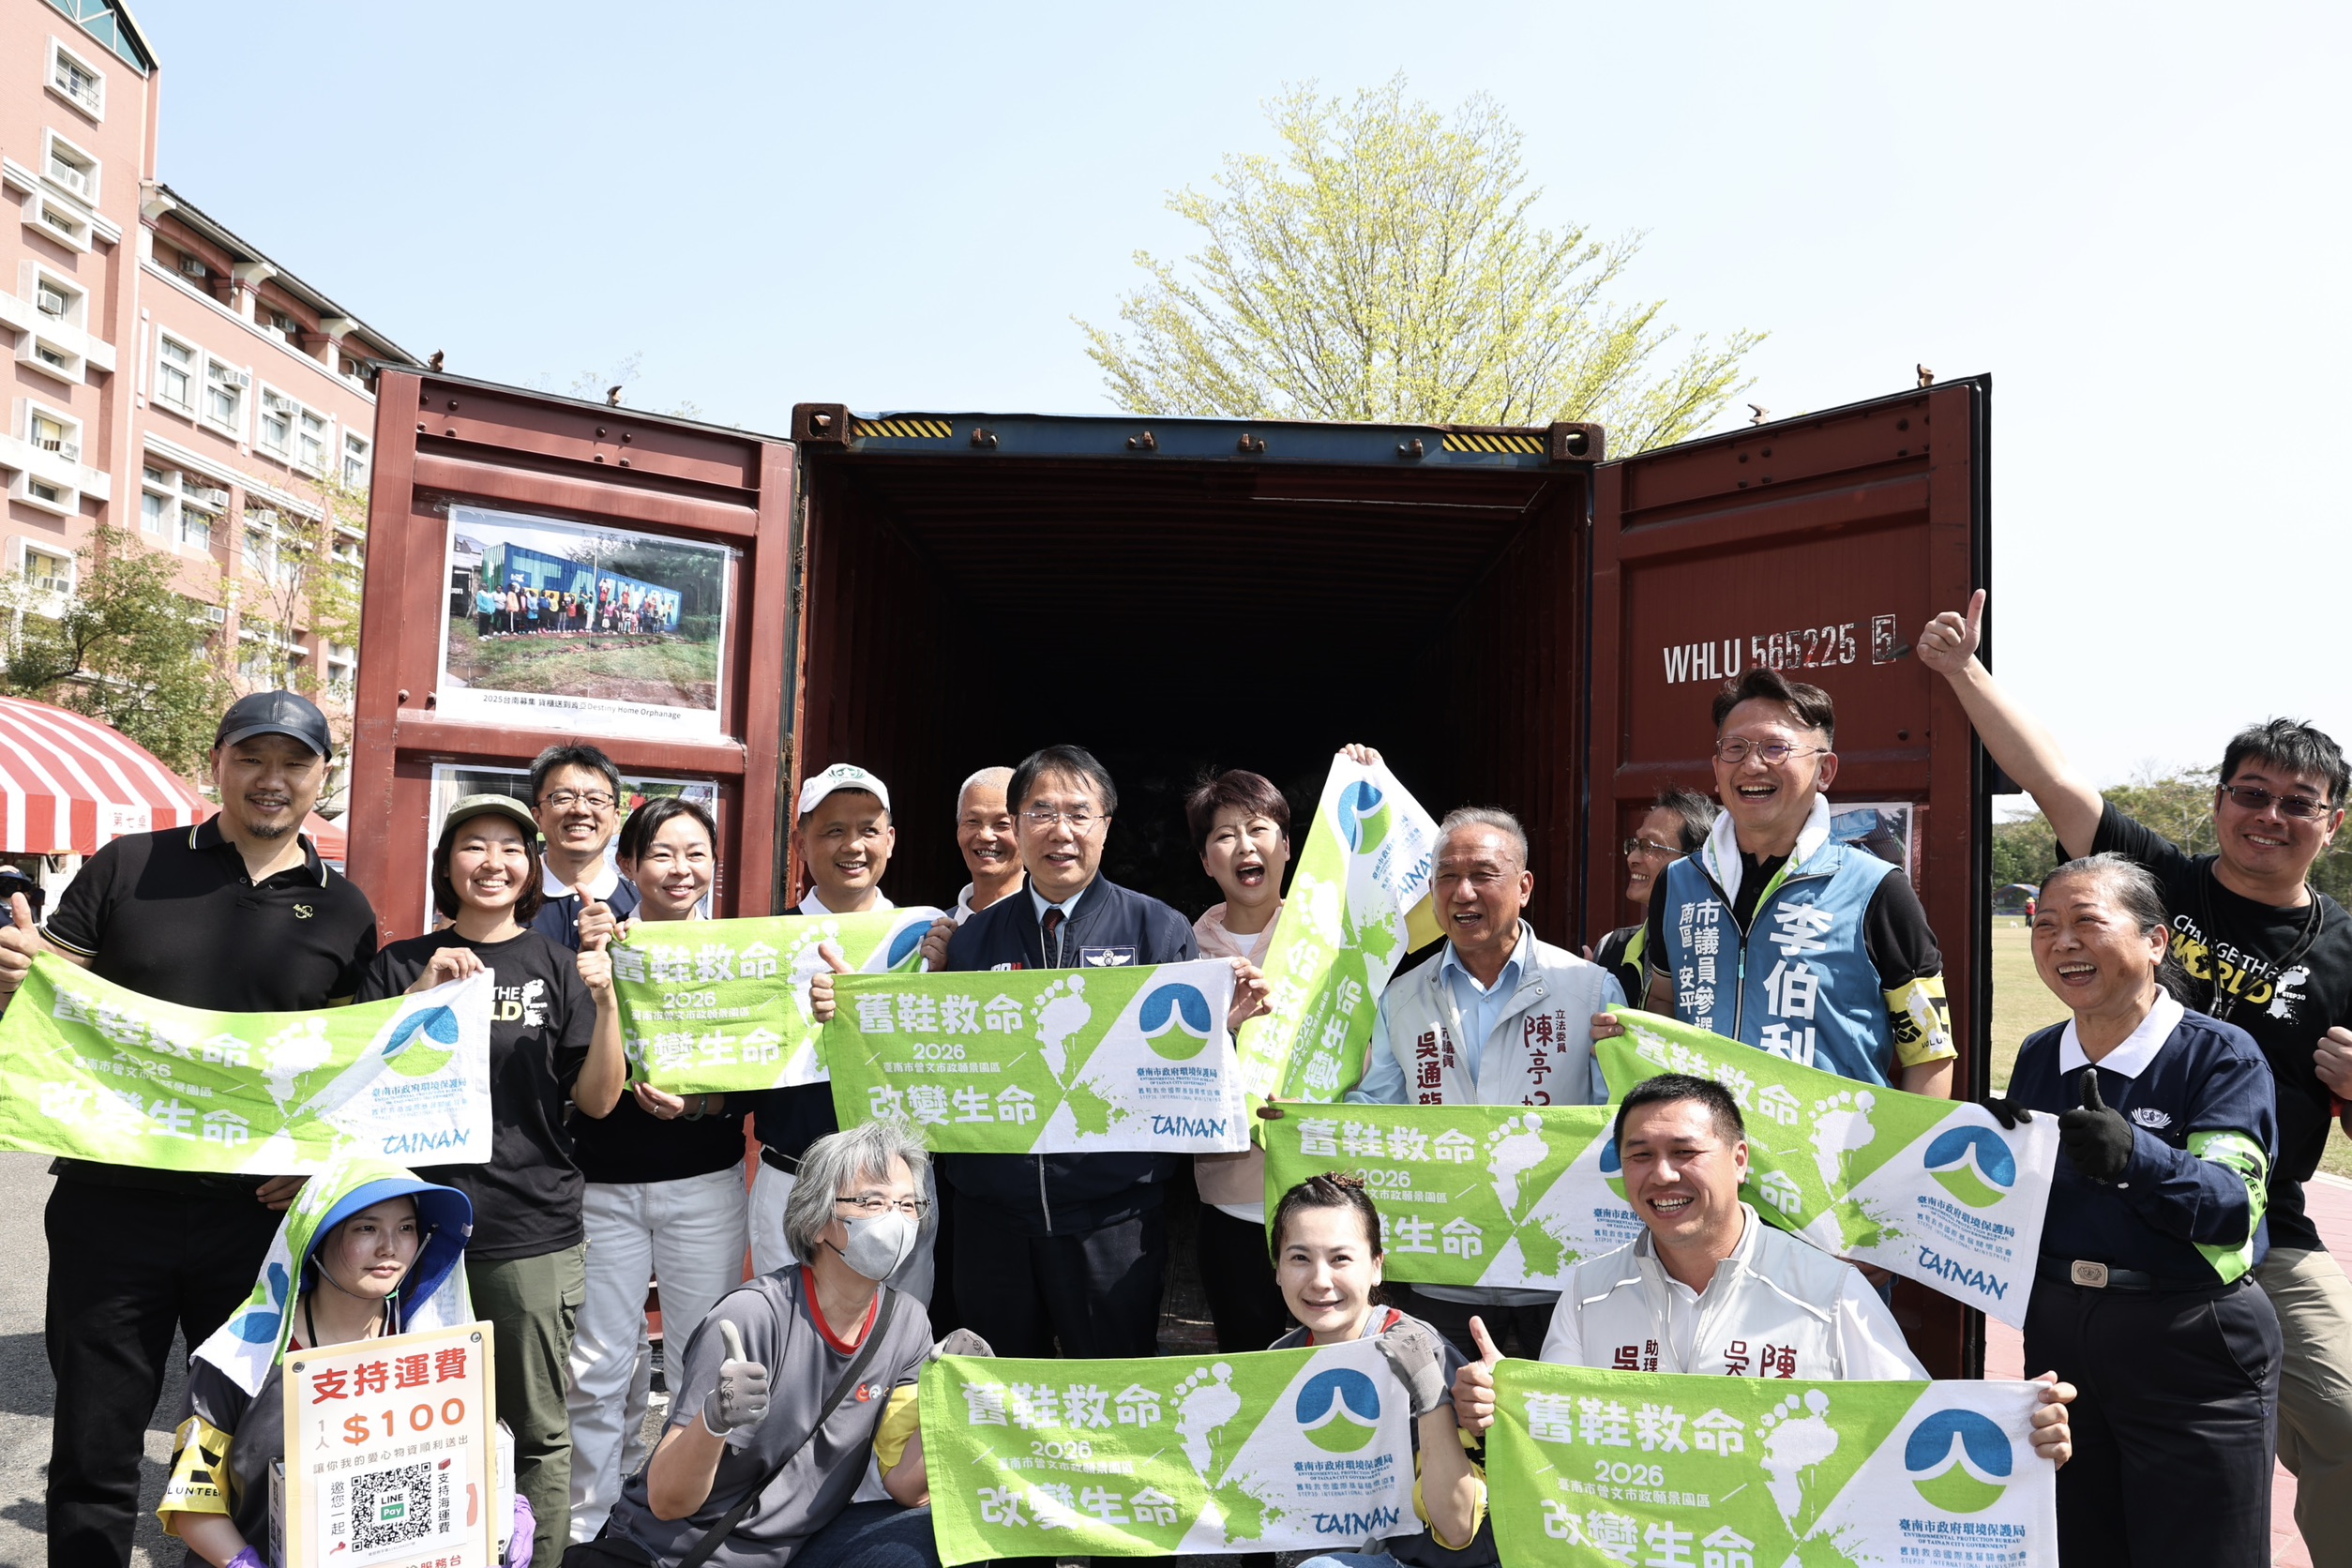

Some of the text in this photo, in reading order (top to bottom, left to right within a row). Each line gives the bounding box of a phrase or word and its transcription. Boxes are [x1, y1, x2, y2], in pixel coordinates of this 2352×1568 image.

[1663, 638, 1741, 684] WHLU
[483, 694, 535, 705] 2025台南募集
[618, 706, 639, 716] Home
[641, 708, 681, 719] Orphanage
[611, 941, 779, 984] 舊鞋救命
[663, 991, 716, 1009] 2026
[1760, 901, 1834, 1068] 李伯利
[2282, 991, 2306, 1001] STEP30
[854, 993, 1024, 1034] 舊鞋救命
[1555, 1009, 1567, 1053] 立法委員
[625, 1027, 781, 1072] 改變生命
[912, 1043, 966, 1061] 2026
[1289, 1013, 1314, 1062] 2026
[883, 1062, 1002, 1074] 臺南市曾文市政願景園區
[1137, 1066, 1217, 1078] 臺南市政府環境保護局
[1628, 1023, 1802, 1126] 舊鞋救命
[867, 1084, 1037, 1125] 改變生命
[382, 1128, 470, 1154] TAINAN
[1151, 1114, 1227, 1138] TAINAN
[1298, 1117, 1476, 1164] 舊鞋救命
[1356, 1168, 1411, 1187] 2026
[1593, 1208, 1644, 1222] 臺南市政府
[1917, 1195, 2014, 1238] 臺南市政府環境保護局
[1974, 1247, 2011, 1263] MINISTRIES
[1919, 1245, 2009, 1301] TAINAN
[312, 1348, 467, 1405] 支持運費
[1760, 1345, 1797, 1380] 陳
[343, 1397, 465, 1446] $100
[960, 1382, 1162, 1429] 舊鞋救命
[1522, 1391, 1745, 1456] 舊鞋救命
[313, 1435, 468, 1474] 讓你我的愛心物資順利送出
[1031, 1440, 1093, 1460] 2026
[1294, 1454, 1393, 1471] 臺南市政府環境保護局
[1594, 1460, 1664, 1487] 2026
[331, 1481, 345, 1536] 邀您一起
[381, 1494, 403, 1505] LINE
[438, 1473, 450, 1535] 支持海運費
[977, 1483, 1178, 1530] 改變生命
[1558, 1477, 1711, 1508] 臺南市曾文市政願景園區
[384, 1507, 402, 1518] Pay
[1311, 1505, 1399, 1535] TAINAN
[1899, 1518, 2026, 1537] 臺南市政府環境保護局
[1541, 1499, 1756, 1568] 改變生命
[1904, 1531, 1955, 1540] ENVIRONMENTAL
[1930, 1560, 1980, 1568] INTERNATIONAL
